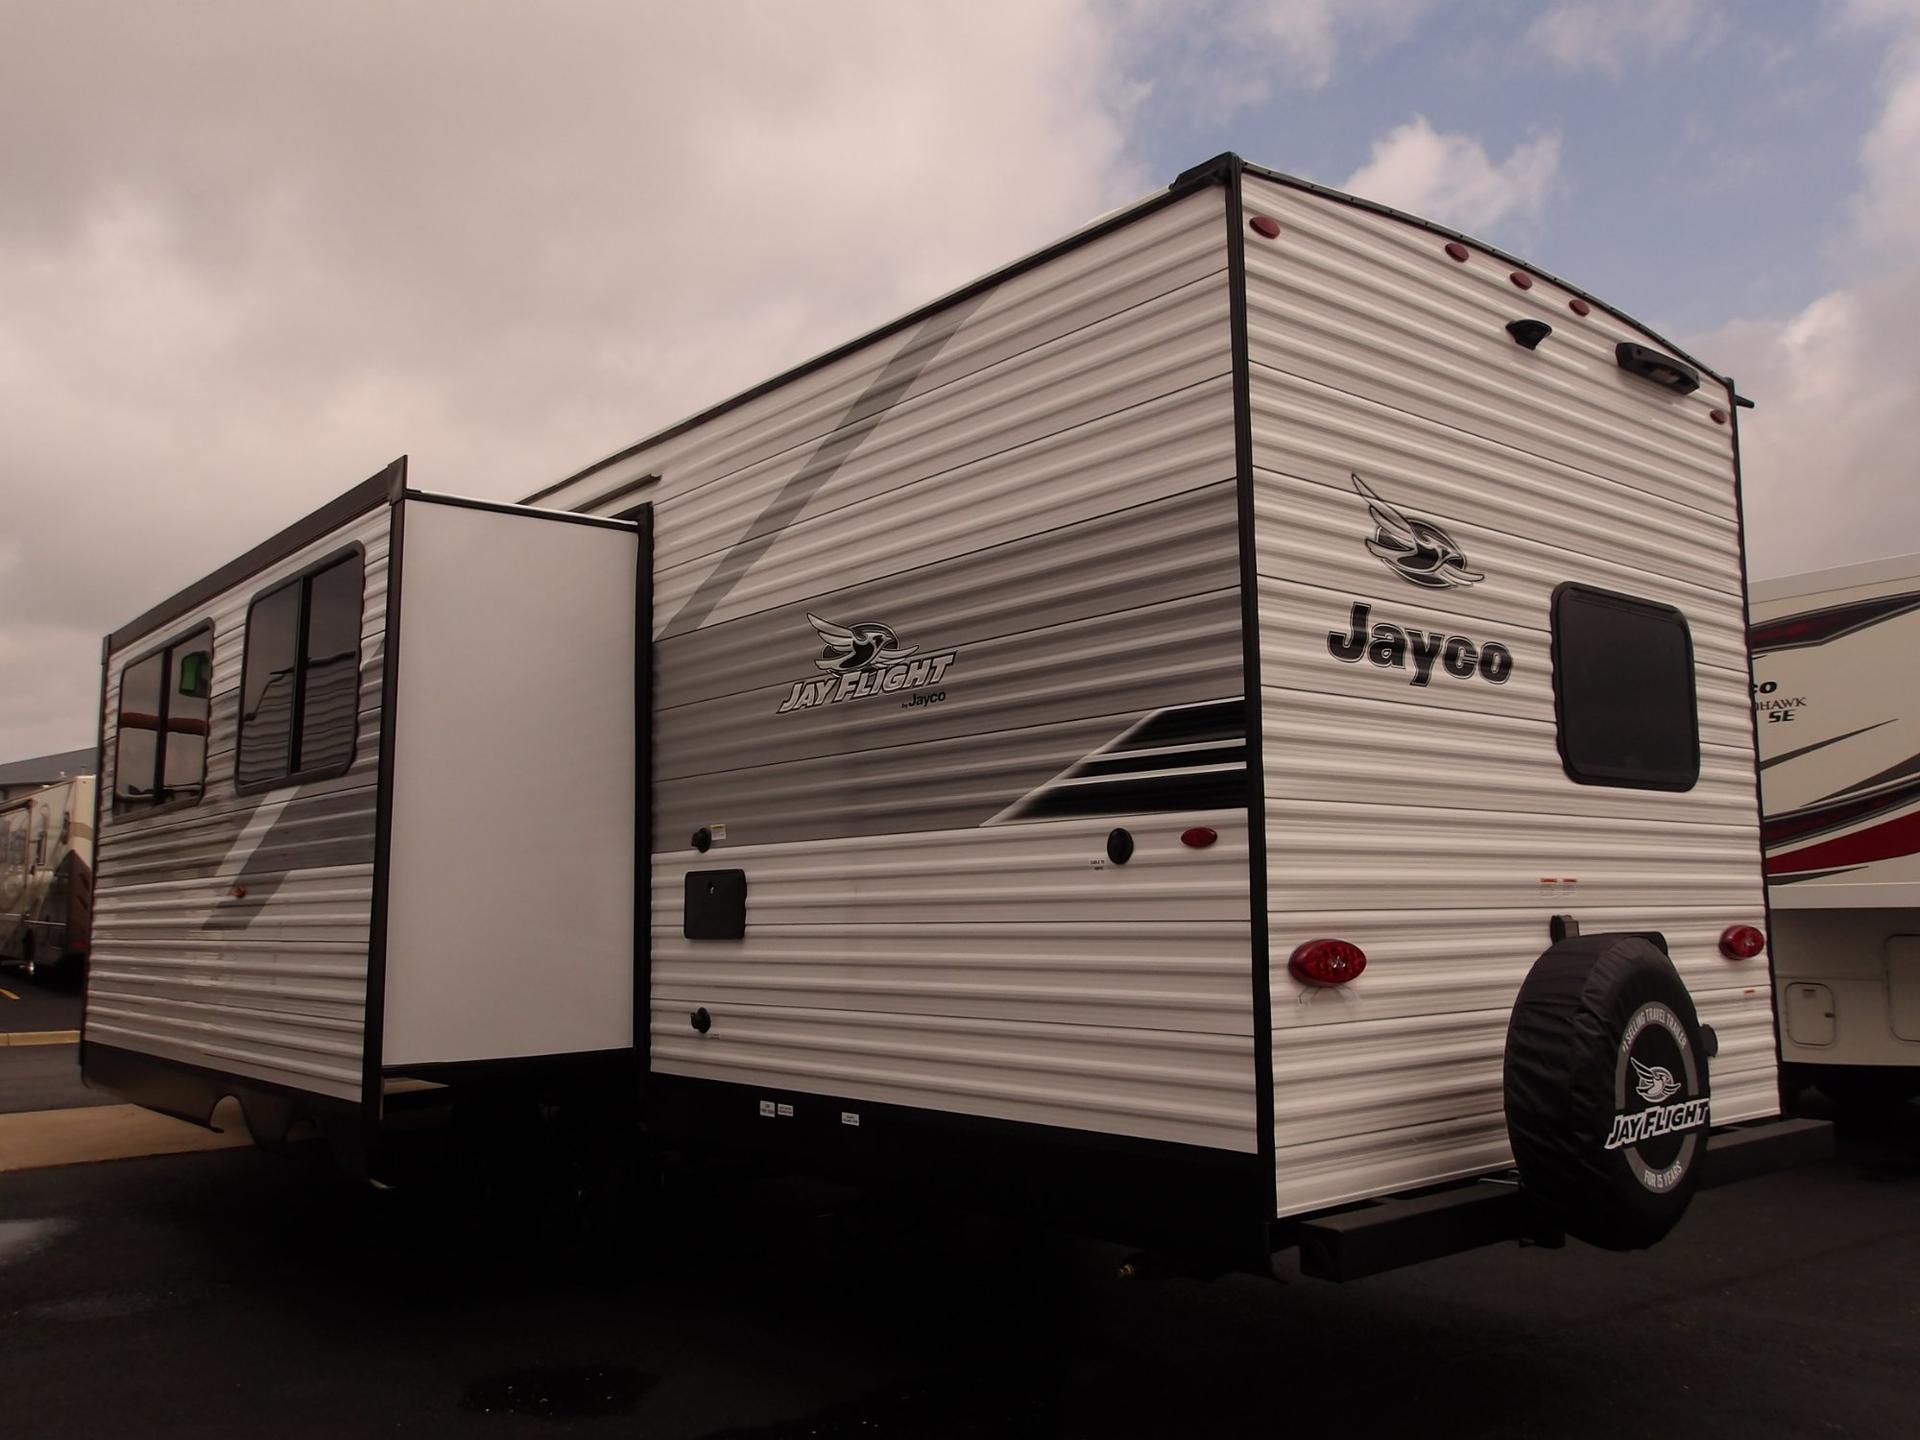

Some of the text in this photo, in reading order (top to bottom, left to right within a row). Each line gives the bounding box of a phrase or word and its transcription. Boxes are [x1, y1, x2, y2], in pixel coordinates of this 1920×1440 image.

[1327, 601, 1513, 687] Jayco
[776, 650, 958, 714] JAY FLIGHT
[908, 691, 946, 707] Jayco
[1768, 709, 1795, 723] SE
[1645, 1007, 1666, 1024] TRAVEL
[1604, 1098, 1710, 1149] JAY FLIGHT
[1644, 1169, 1656, 1188] FOR
[1663, 1160, 1682, 1187] YEARS
